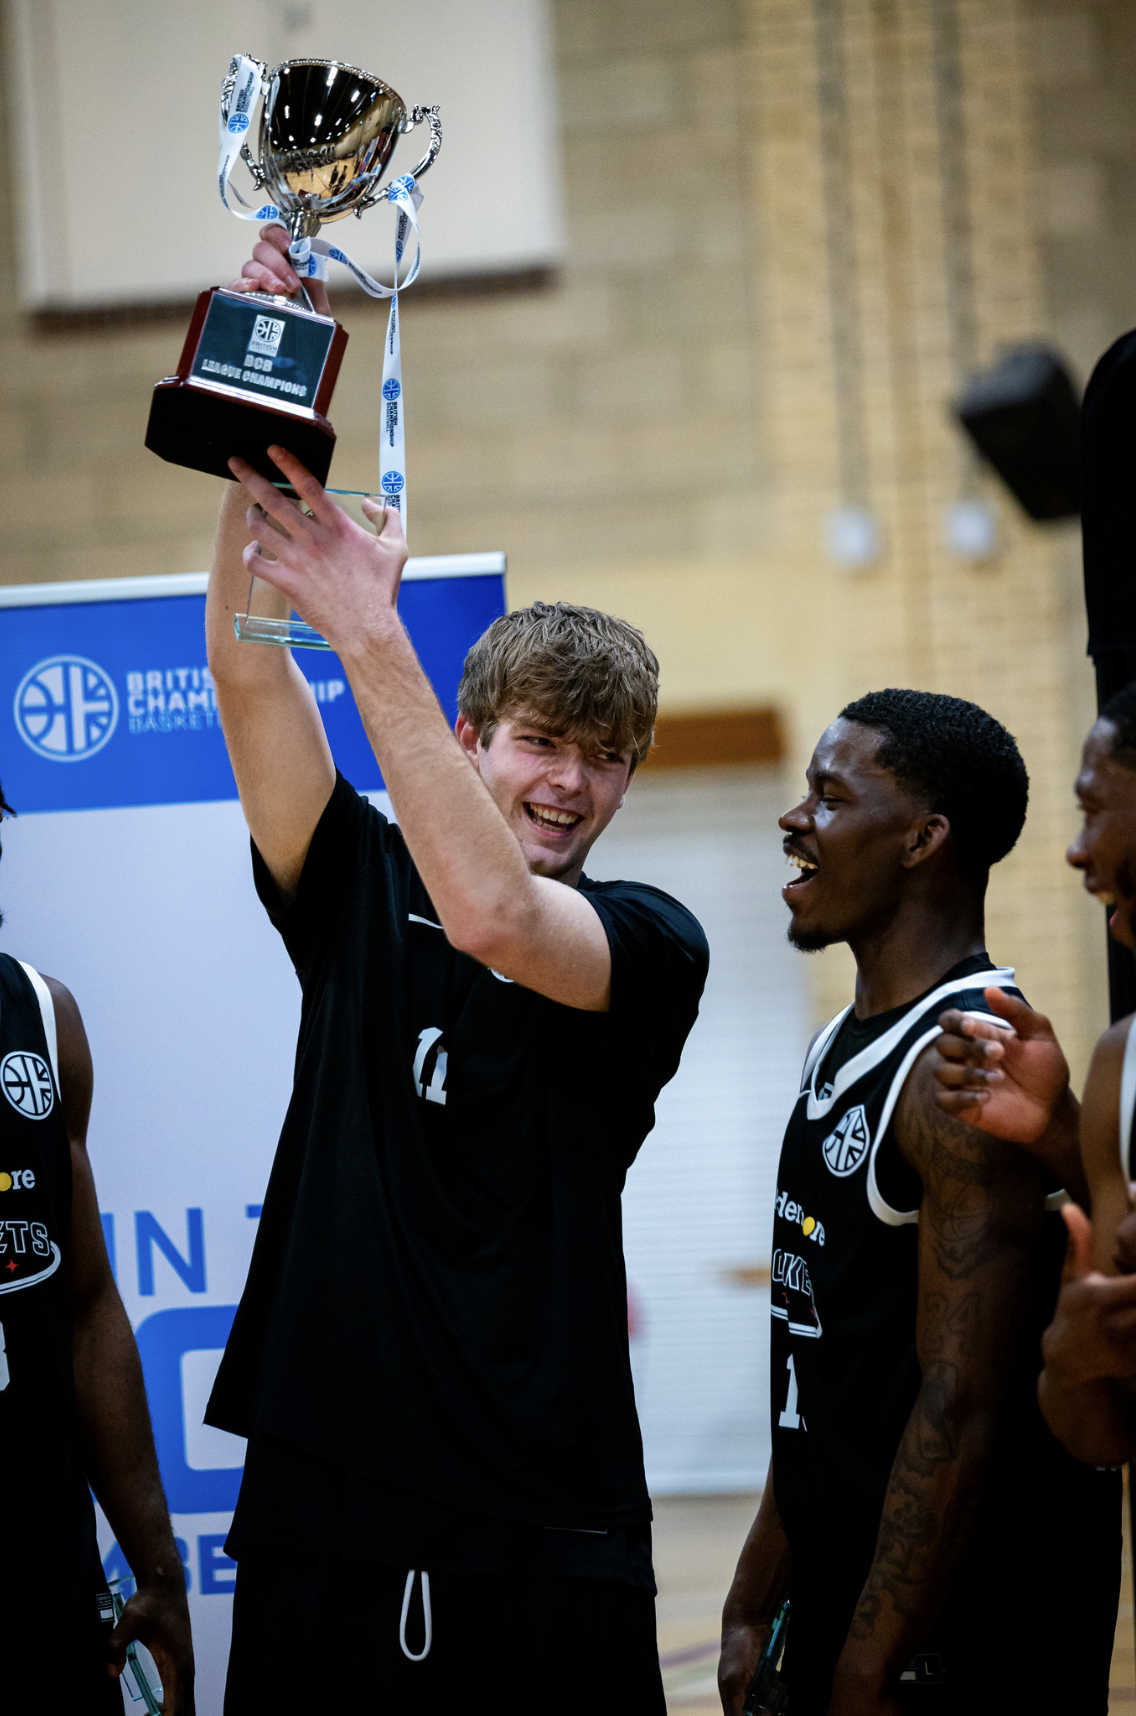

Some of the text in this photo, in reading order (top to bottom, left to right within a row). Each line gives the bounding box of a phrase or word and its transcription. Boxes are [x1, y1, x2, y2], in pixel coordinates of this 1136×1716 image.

[243, 354, 273, 373] BCB
[201, 358, 307, 397] LEAGUE CHAMPIONS
[127, 666, 214, 691] BRITIS
